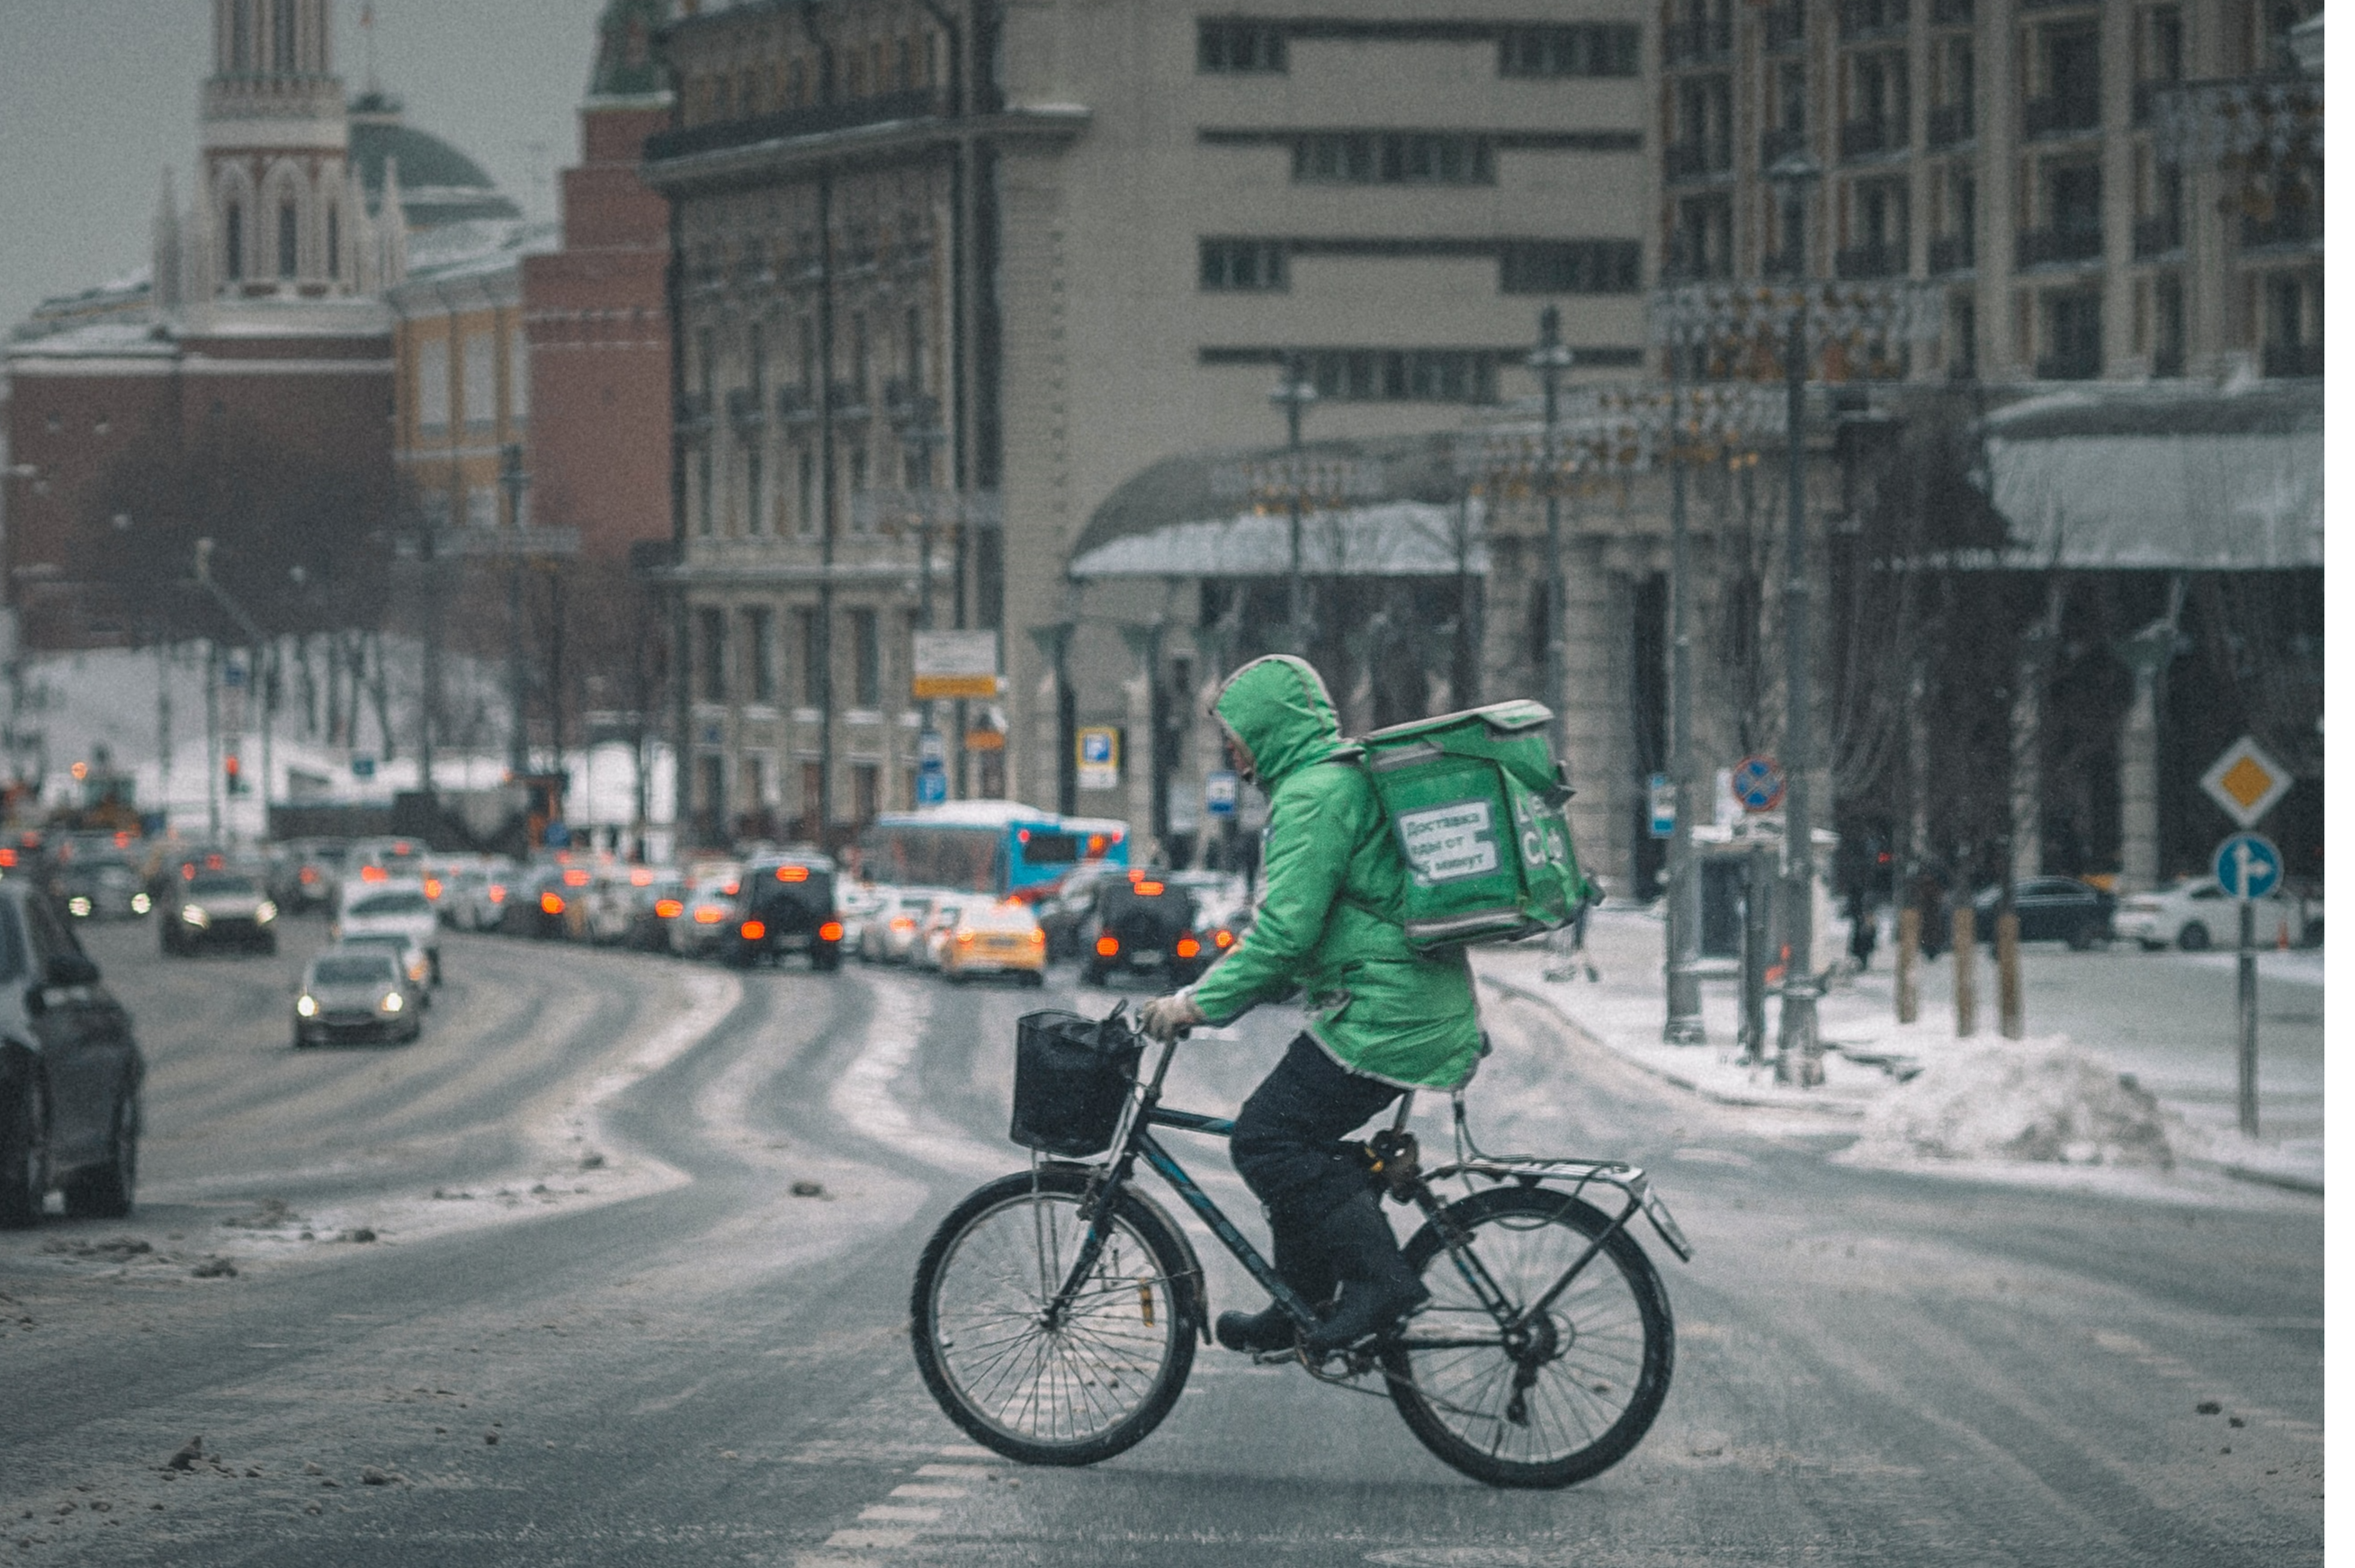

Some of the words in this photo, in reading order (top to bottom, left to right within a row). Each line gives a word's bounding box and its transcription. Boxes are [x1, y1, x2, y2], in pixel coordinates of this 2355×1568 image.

[1406, 812, 1480, 837] Доставка
[1445, 835, 1464, 848] от
[1435, 853, 1483, 870] минут
